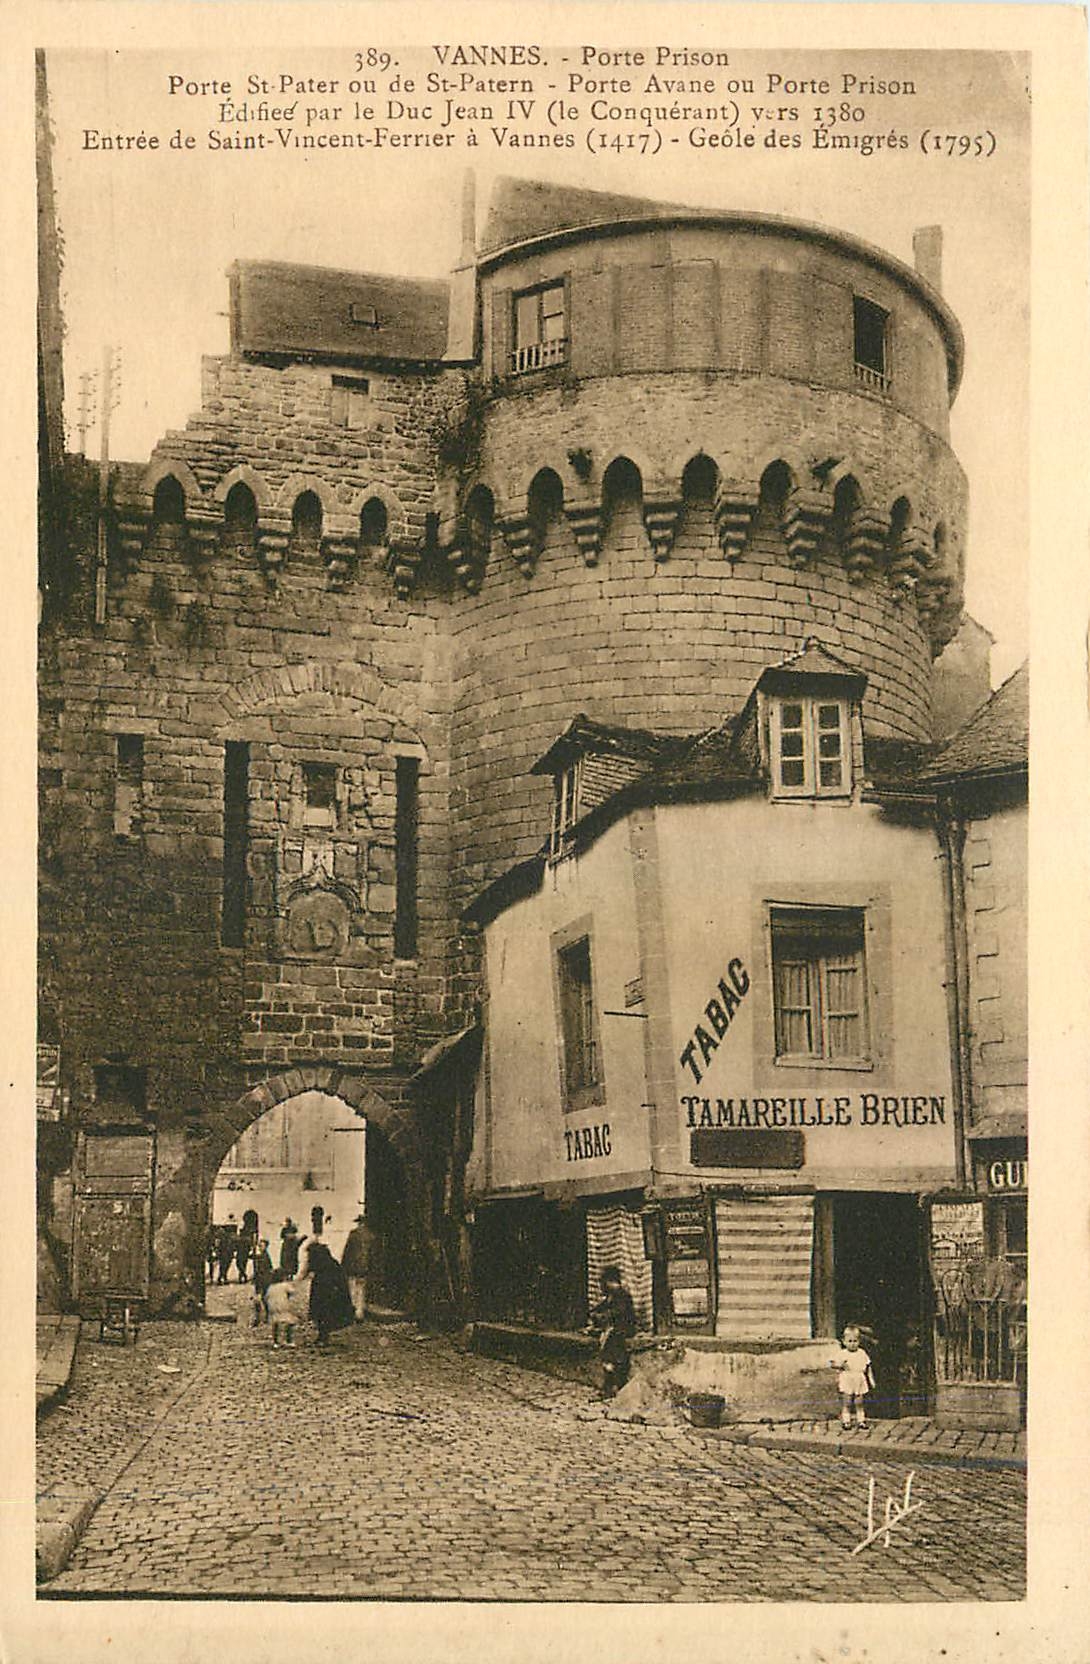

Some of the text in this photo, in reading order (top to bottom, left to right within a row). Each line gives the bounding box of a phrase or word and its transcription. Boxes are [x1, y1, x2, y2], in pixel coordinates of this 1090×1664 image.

[680, 957, 752, 1084] TABAC
[681, 1093, 947, 1130] TAMAREILLE BRIEN
[563, 1123, 612, 1163] TABAC
